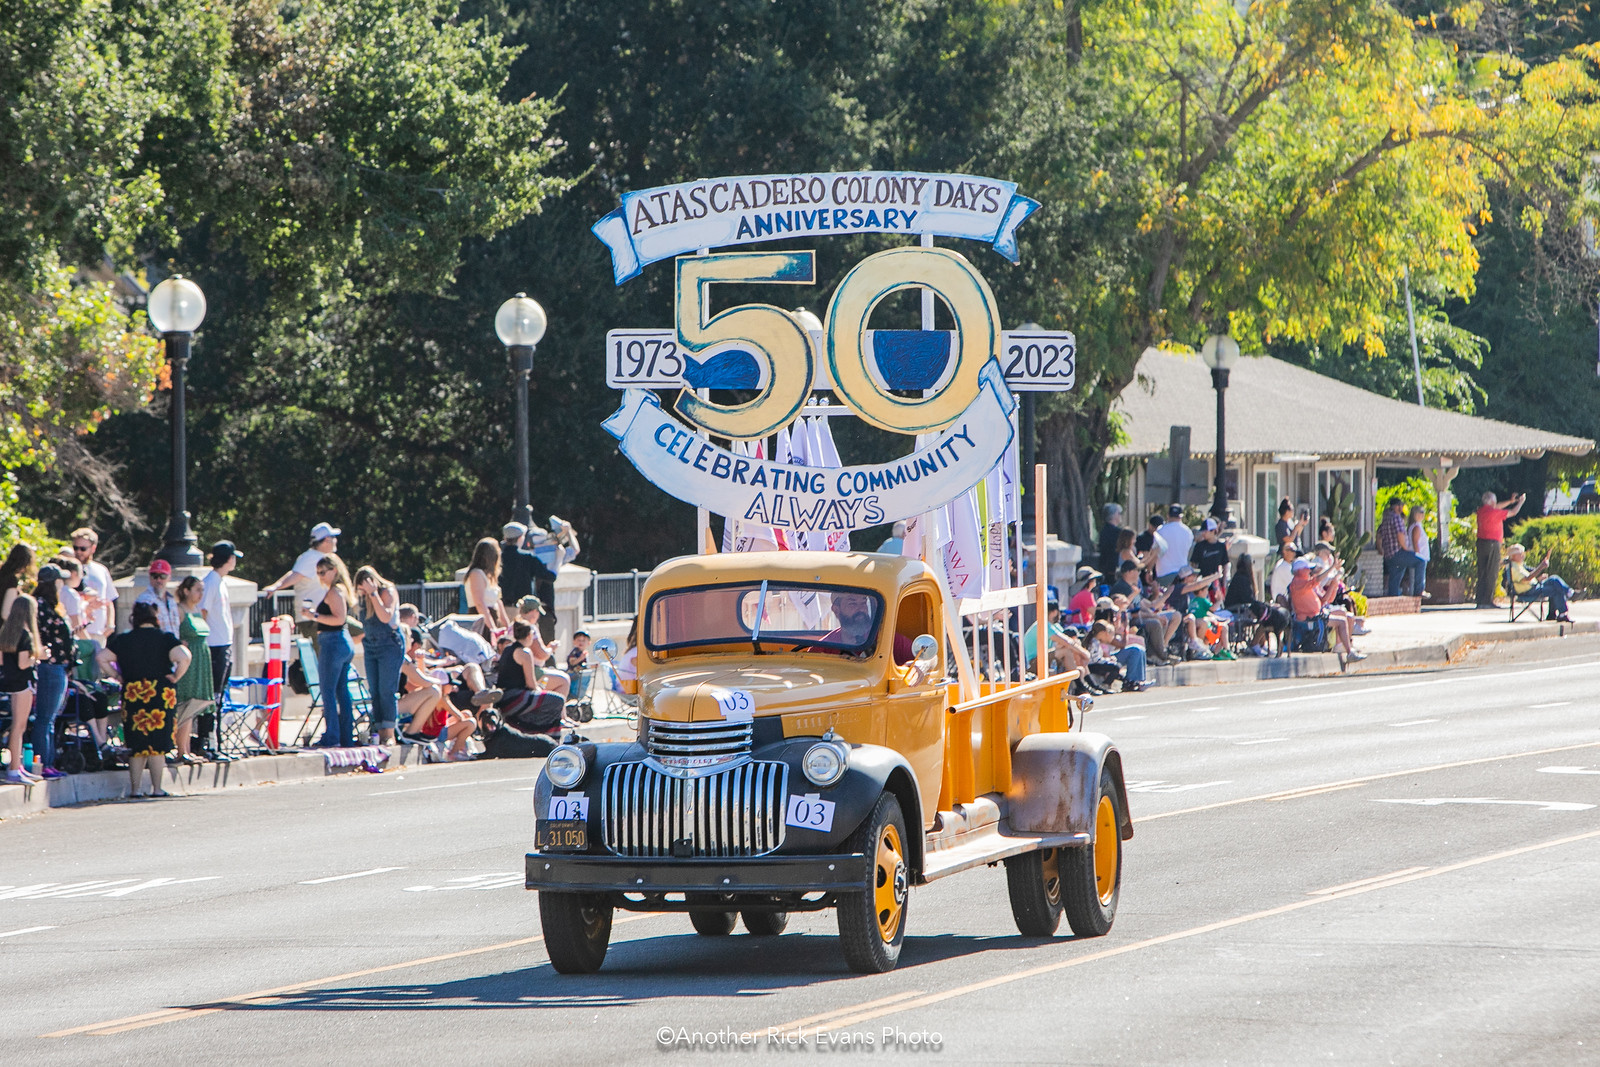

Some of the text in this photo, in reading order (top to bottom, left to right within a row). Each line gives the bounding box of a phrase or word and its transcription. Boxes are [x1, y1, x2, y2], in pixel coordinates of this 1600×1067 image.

[632, 176, 1002, 236] ATASCADERO COLONY DAYS
[736, 208, 919, 240] ANNIVERSARY
[615, 340, 682, 378] 1973
[674, 246, 1002, 441] 50
[1004, 344, 1075, 378] 2023
[653, 423, 826, 495] CELEBRATING
[836, 425, 976, 497] COMMUNITY
[744, 492, 885, 532] ALWAYS
[723, 691, 749, 711] 03
[795, 799, 825, 826] 03
[549, 830, 563, 847] 31
[564, 830, 585, 847] 050
